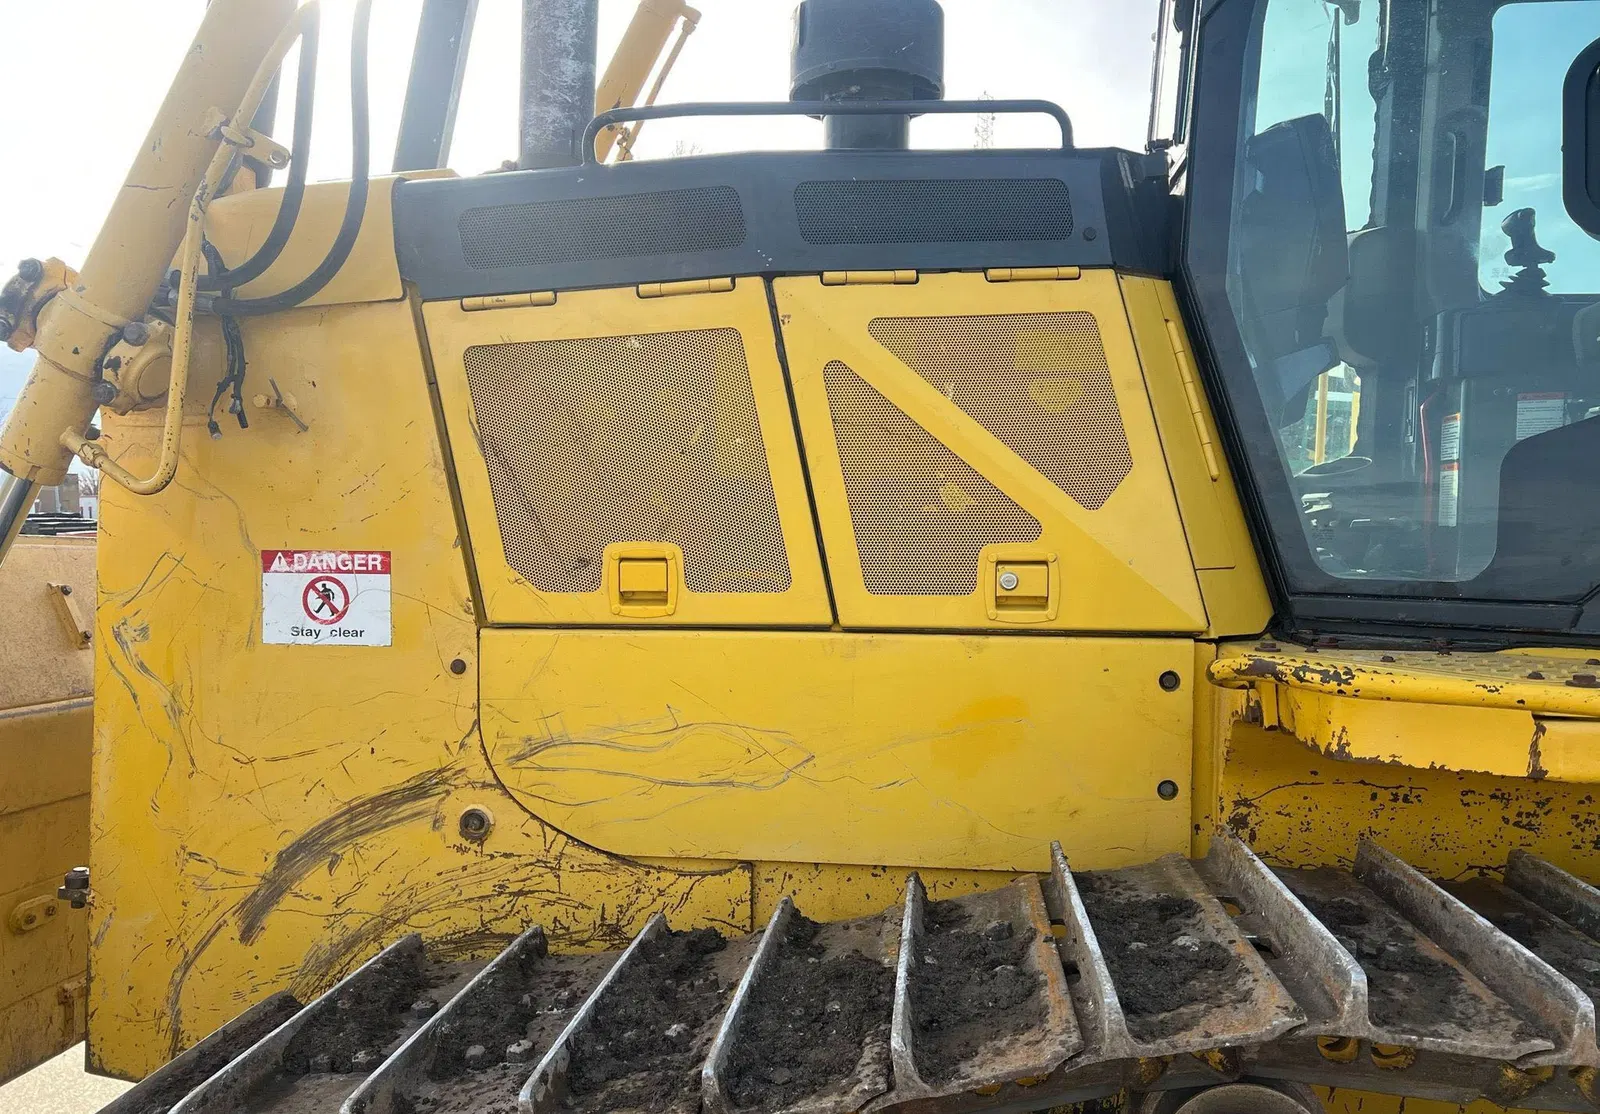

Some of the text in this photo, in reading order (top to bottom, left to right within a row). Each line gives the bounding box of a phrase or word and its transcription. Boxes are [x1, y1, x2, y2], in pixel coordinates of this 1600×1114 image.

[293, 553, 382, 571] DANGER
[291, 627, 365, 639] Stay clear
